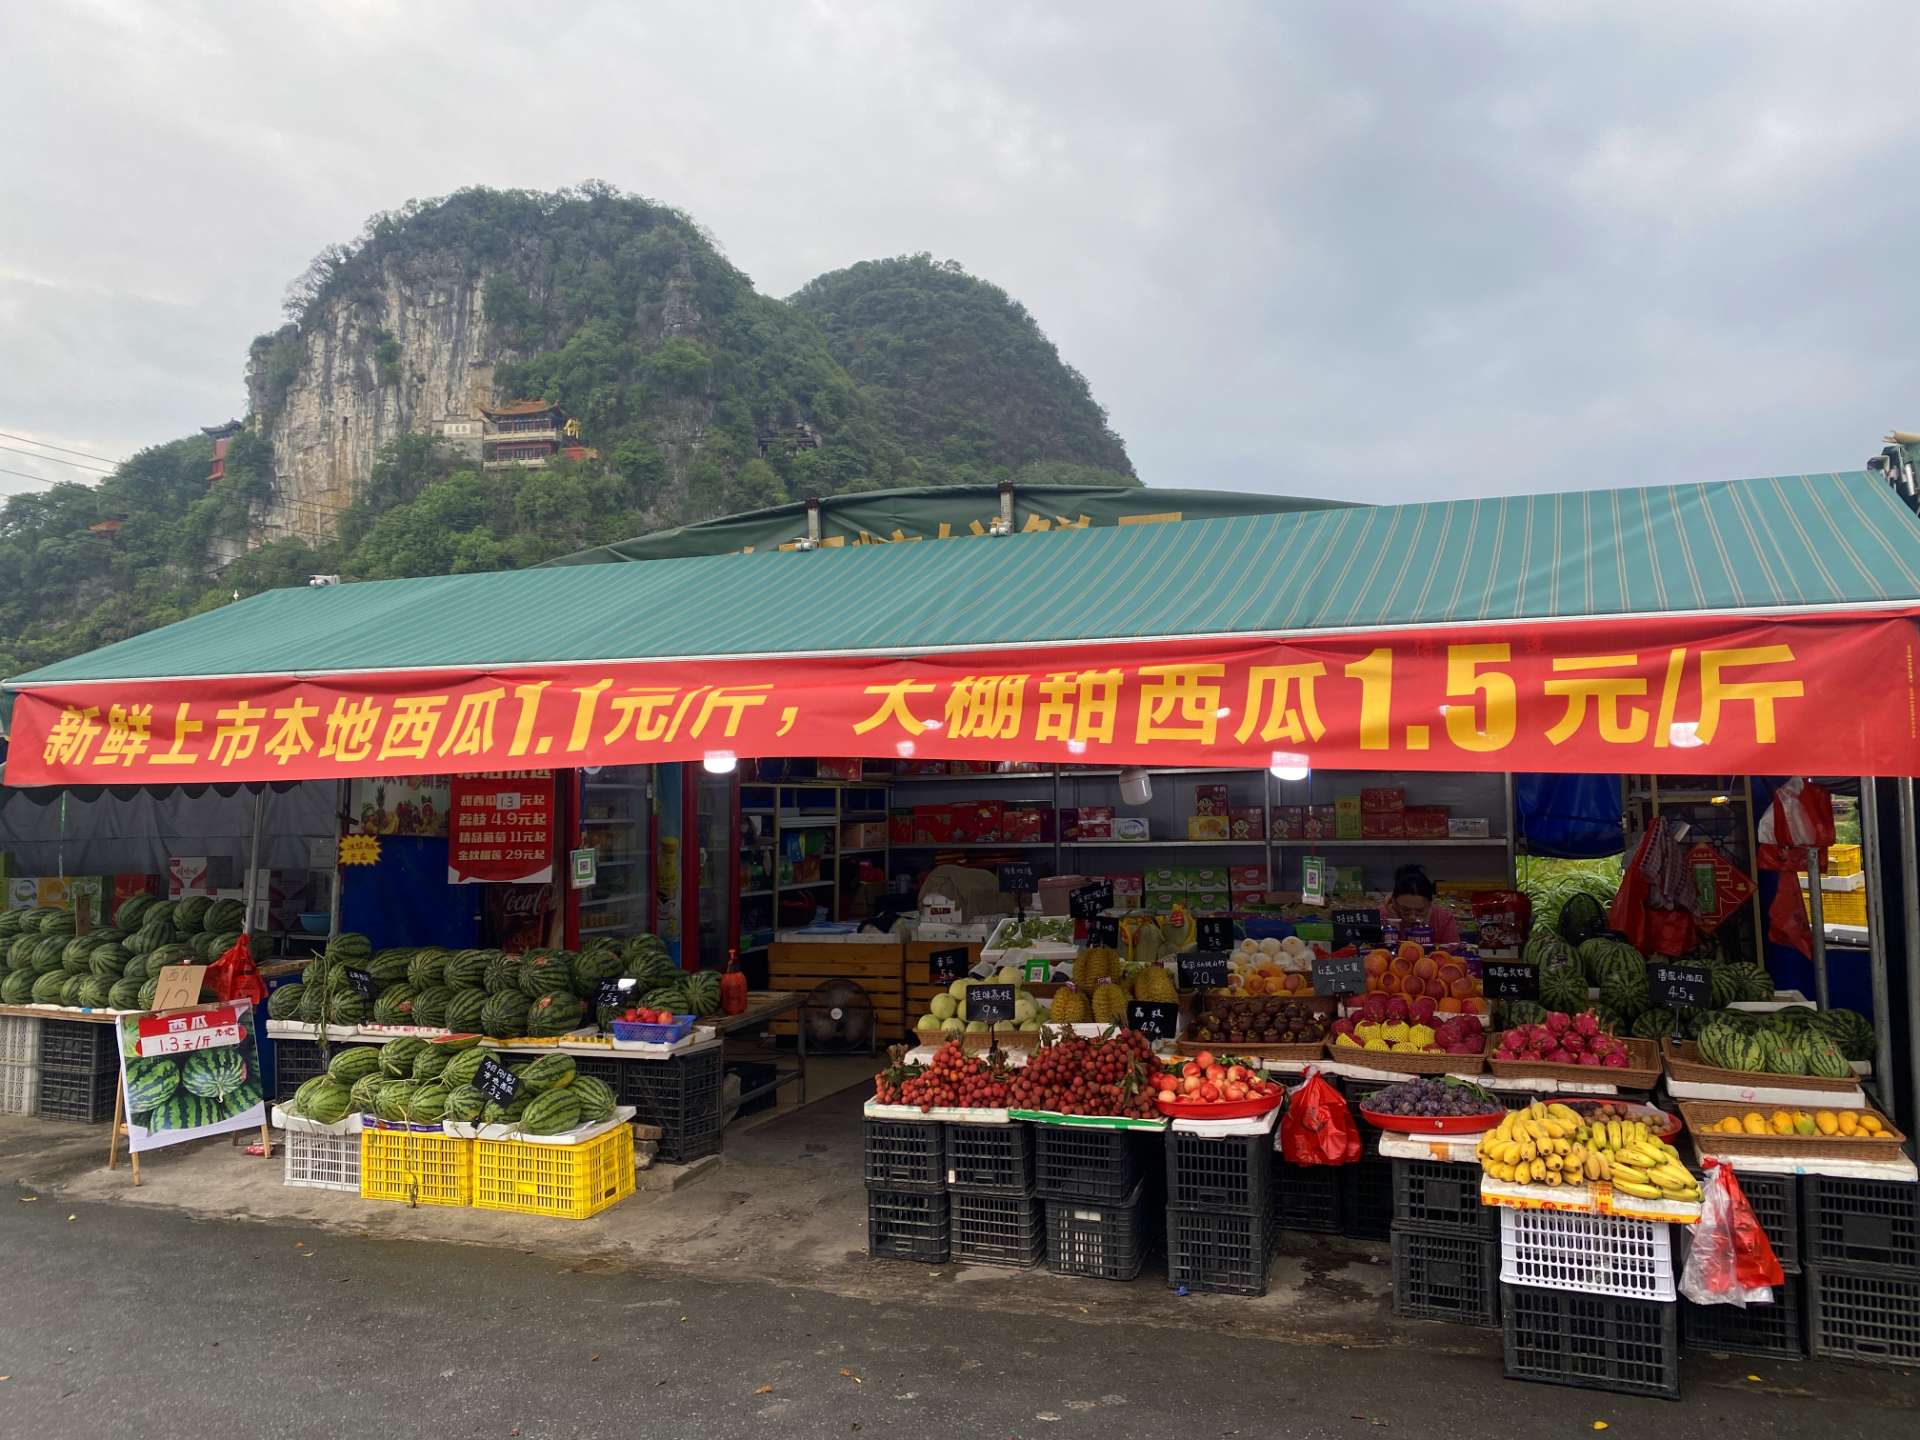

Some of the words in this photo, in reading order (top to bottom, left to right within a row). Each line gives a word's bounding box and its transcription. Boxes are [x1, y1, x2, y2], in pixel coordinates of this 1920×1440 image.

[491, 813, 546, 825] 4.9元起
[168, 1015, 209, 1033] 西瓜
[159, 1034, 211, 1052] 1.3元/斤
